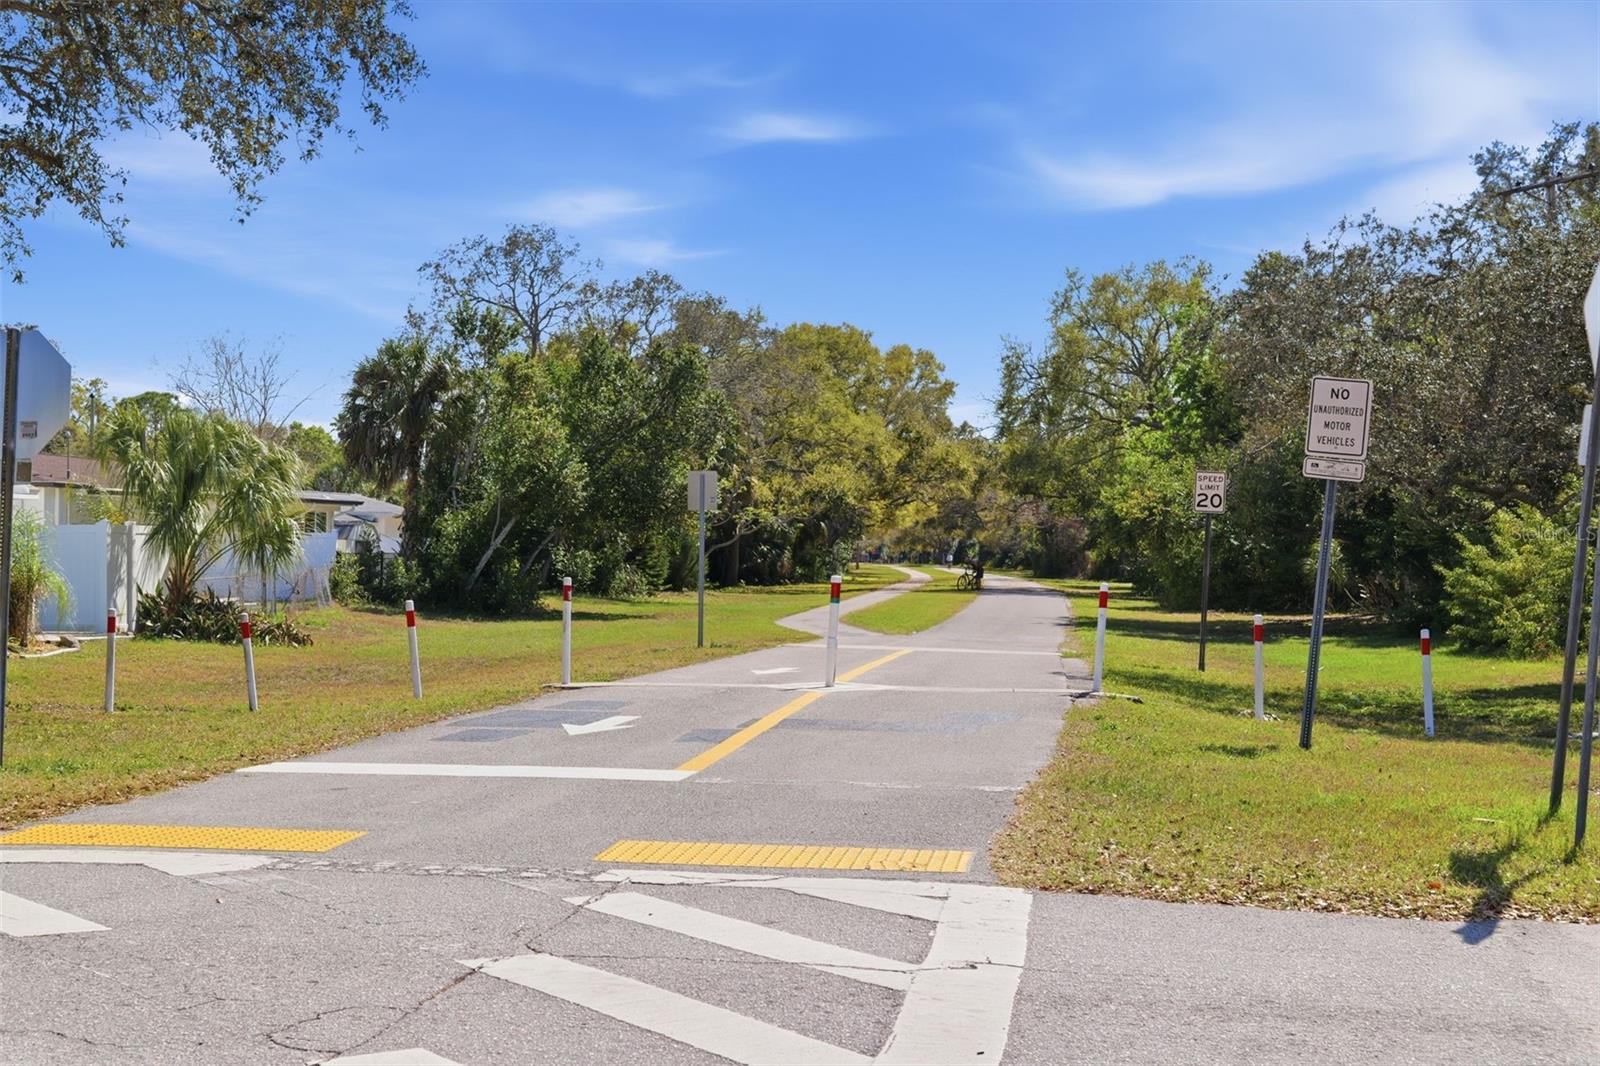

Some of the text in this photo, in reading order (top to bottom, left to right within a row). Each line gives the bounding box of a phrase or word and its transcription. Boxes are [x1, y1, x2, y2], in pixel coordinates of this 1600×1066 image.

[1330, 387, 1350, 400] NO
[1313, 405, 1364, 417] UNAUTHORIZED
[1324, 420, 1351, 431] MOTOR
[1317, 435, 1355, 447] VEHICLES
[1198, 475, 1224, 483] SPEED
[1196, 492, 1222, 508] 20
